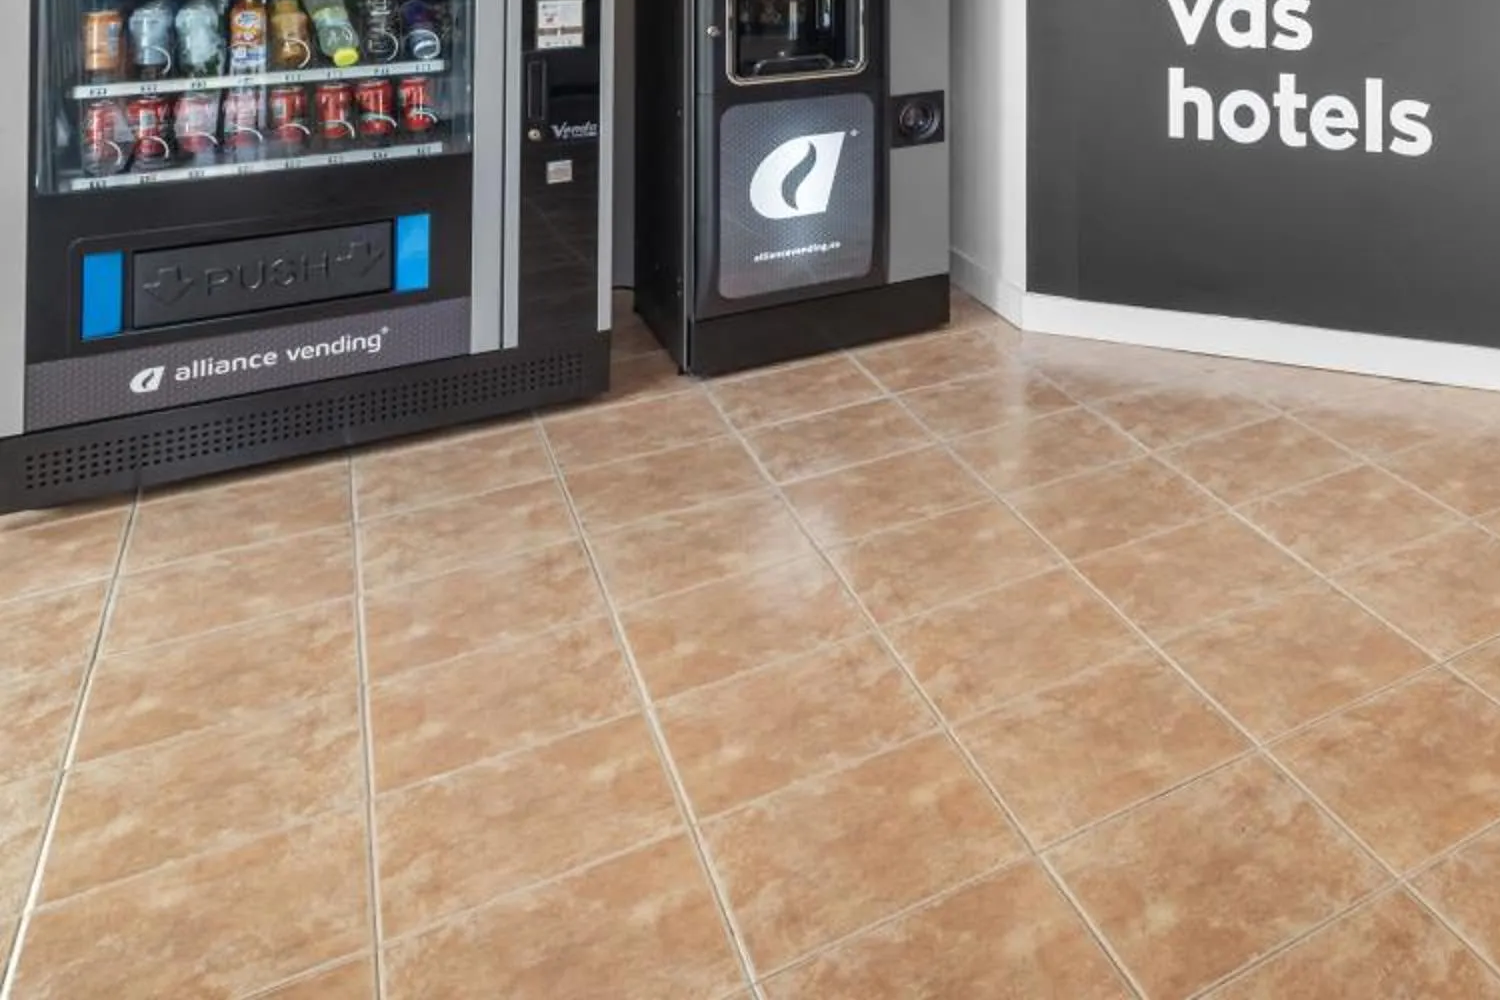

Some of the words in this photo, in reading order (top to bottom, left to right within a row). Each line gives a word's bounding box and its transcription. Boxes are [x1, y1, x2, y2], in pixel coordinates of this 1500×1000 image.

[1168, 67, 1433, 156] hotels
[205, 250, 331, 297] PUSH
[174, 348, 277, 383] alliance
[285, 329, 383, 364] vending
